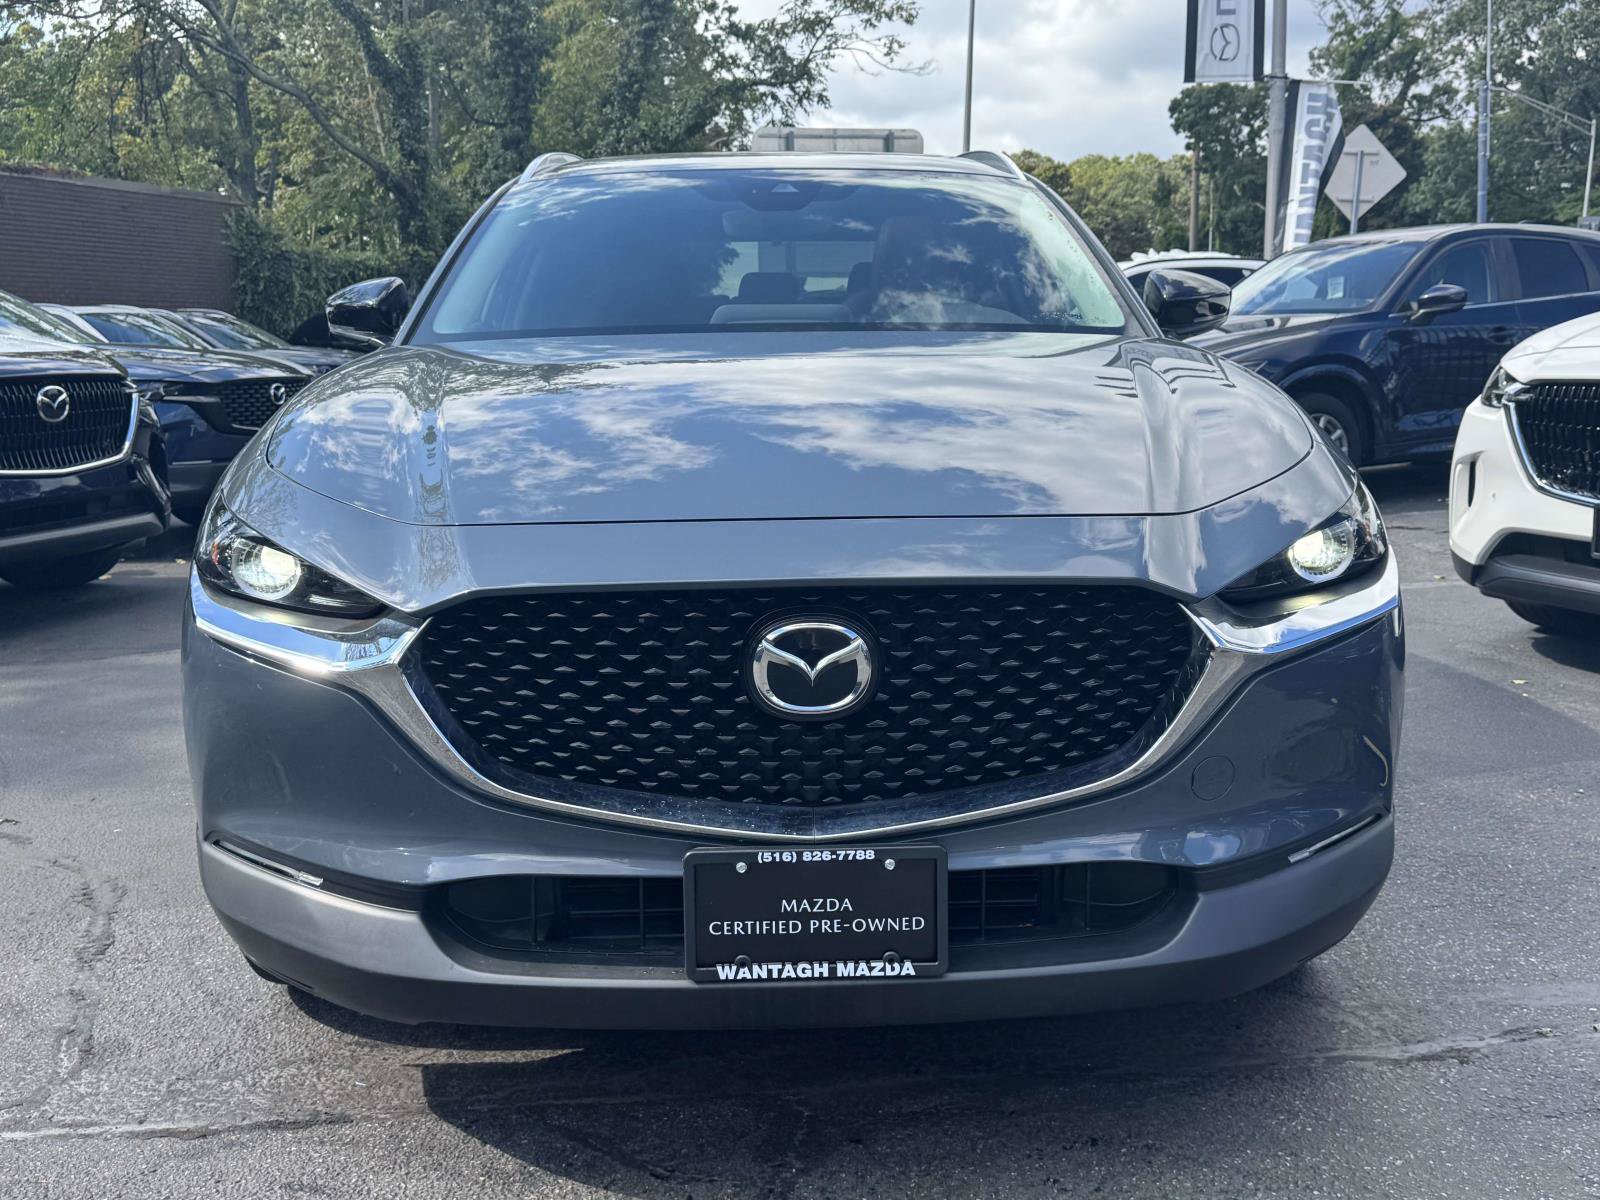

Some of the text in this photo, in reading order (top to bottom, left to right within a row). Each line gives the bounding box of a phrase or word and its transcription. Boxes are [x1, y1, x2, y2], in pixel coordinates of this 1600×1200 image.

[757, 850, 875, 863] (516) 826-7788
[780, 898, 853, 913] MAZDA
[709, 916, 925, 935] CERTIFIED PRE-OWNED
[716, 960, 916, 979] WANTAGH MAZDA
